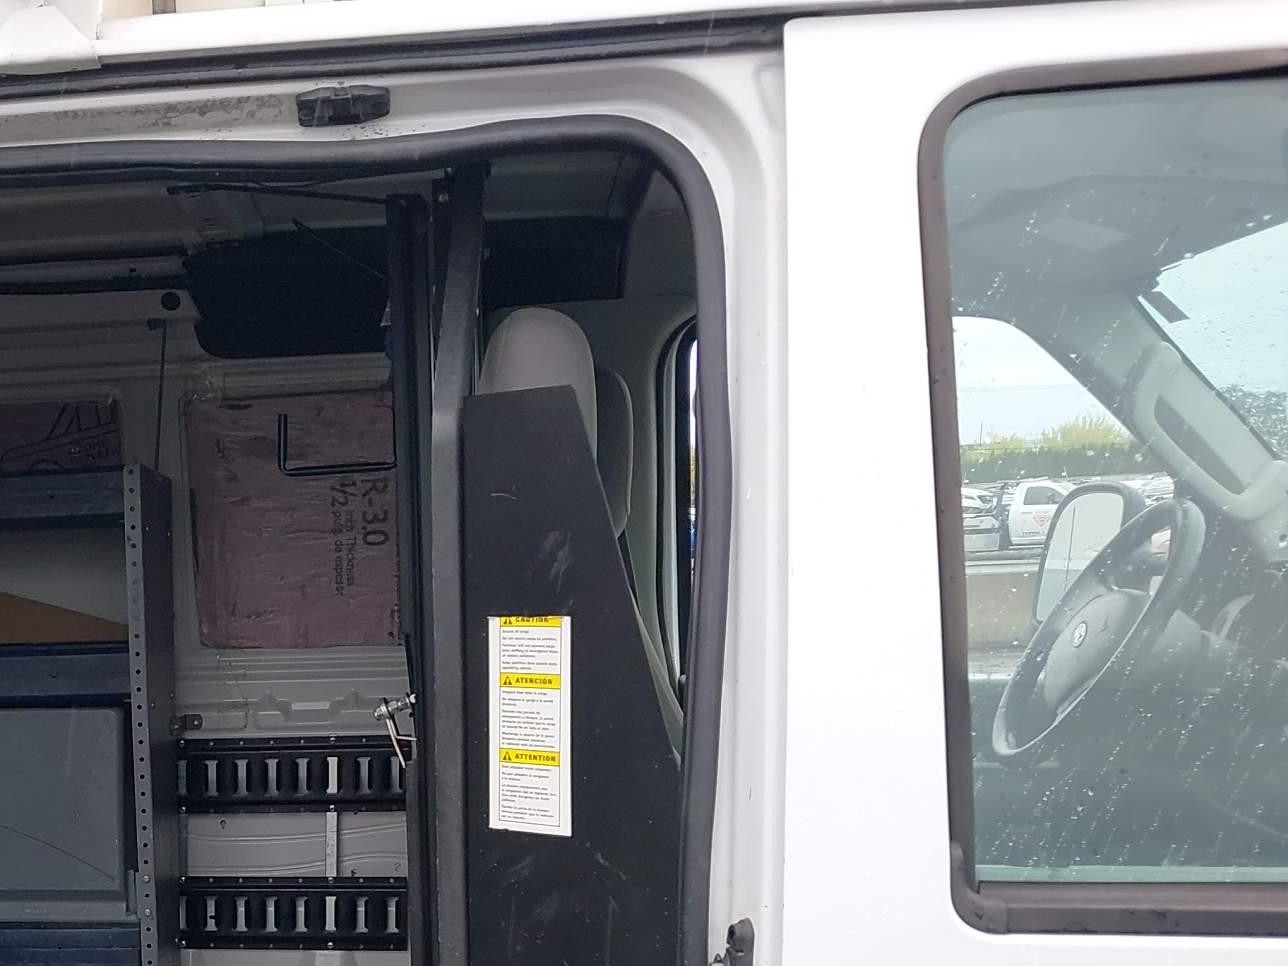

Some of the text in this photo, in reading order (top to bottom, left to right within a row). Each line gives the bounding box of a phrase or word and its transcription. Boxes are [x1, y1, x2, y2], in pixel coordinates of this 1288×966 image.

[330, 481, 358, 508] 1/2
[361, 478, 390, 545] R-3.0
[515, 676, 553, 685] ATENCION
[515, 752, 556, 762] ATTENTION
